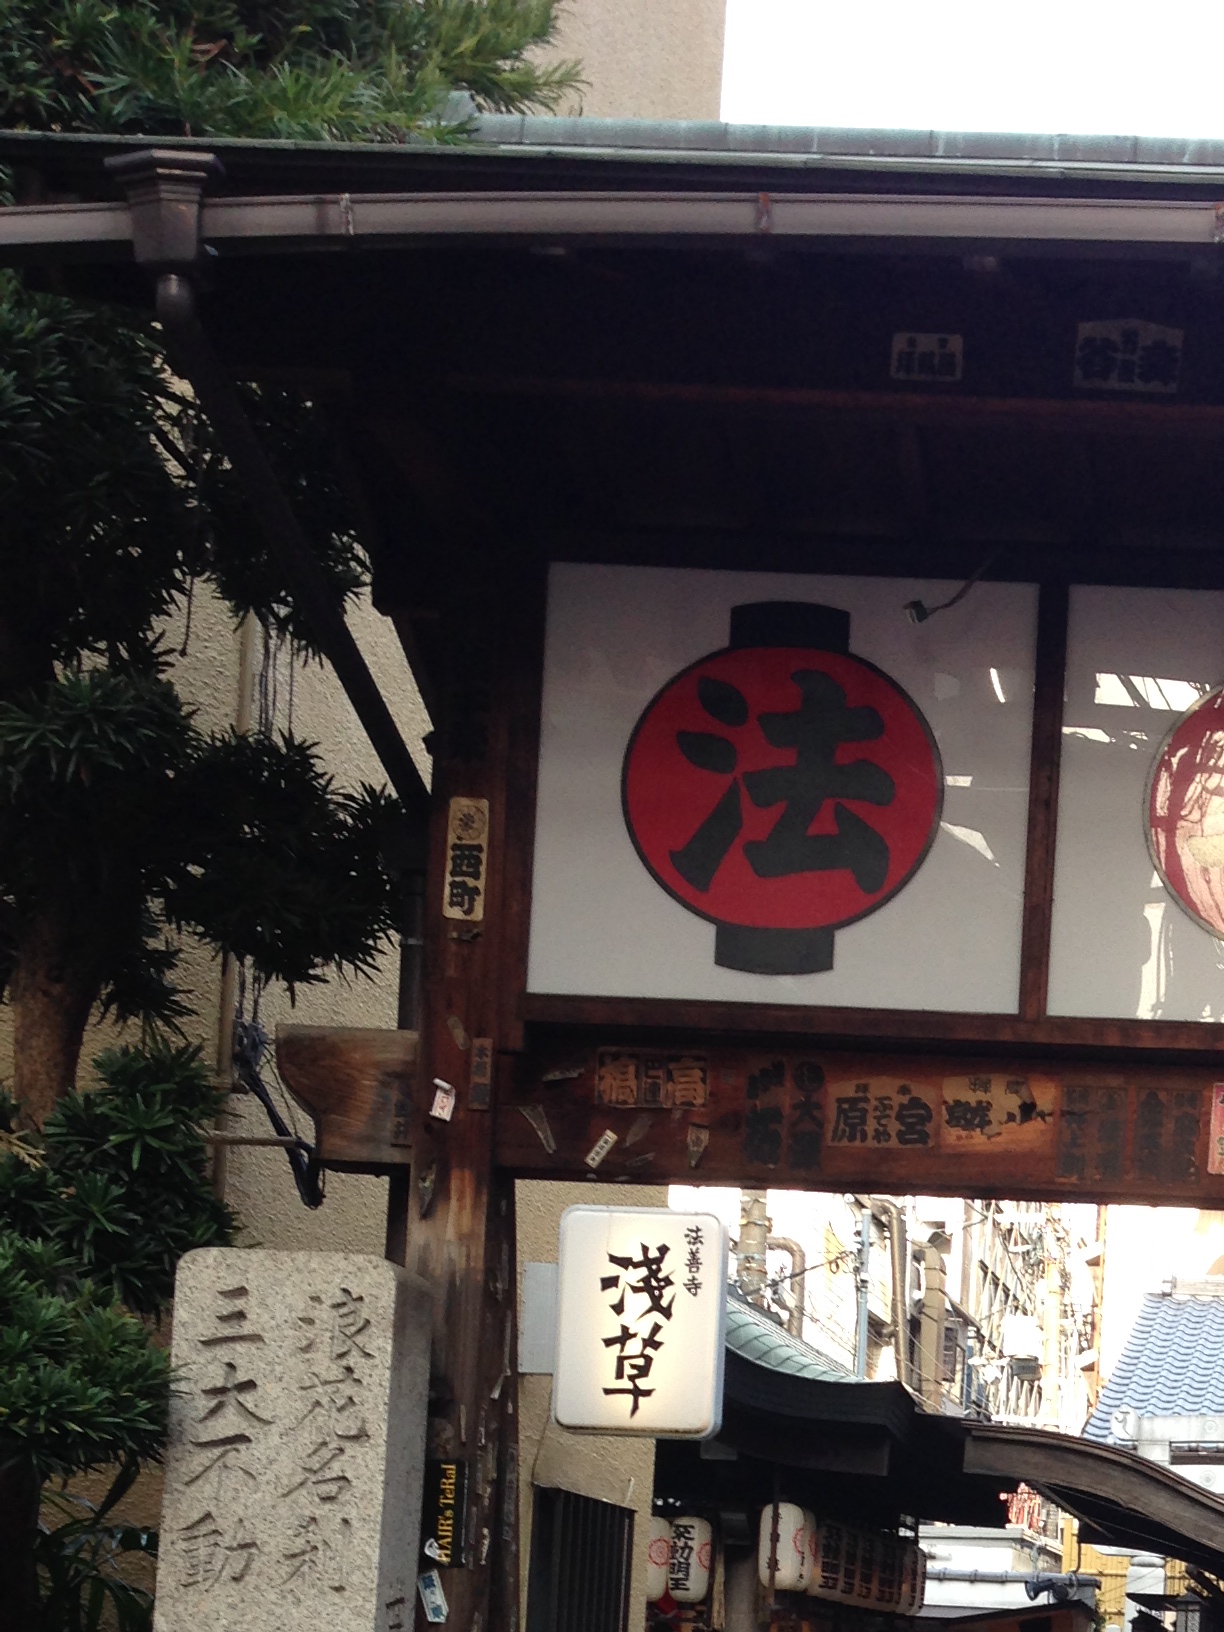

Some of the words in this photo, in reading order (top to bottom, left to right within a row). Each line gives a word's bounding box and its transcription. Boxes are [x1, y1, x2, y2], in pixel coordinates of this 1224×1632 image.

[668, 669, 895, 893] 法
[830, 1095, 869, 1145] 原
[894, 1098, 934, 1145] 宮
[683, 1225, 705, 1297] 法善寺
[178, 1284, 277, 1594] 三大不動
[281, 1286, 378, 1594] 浪花名刹
